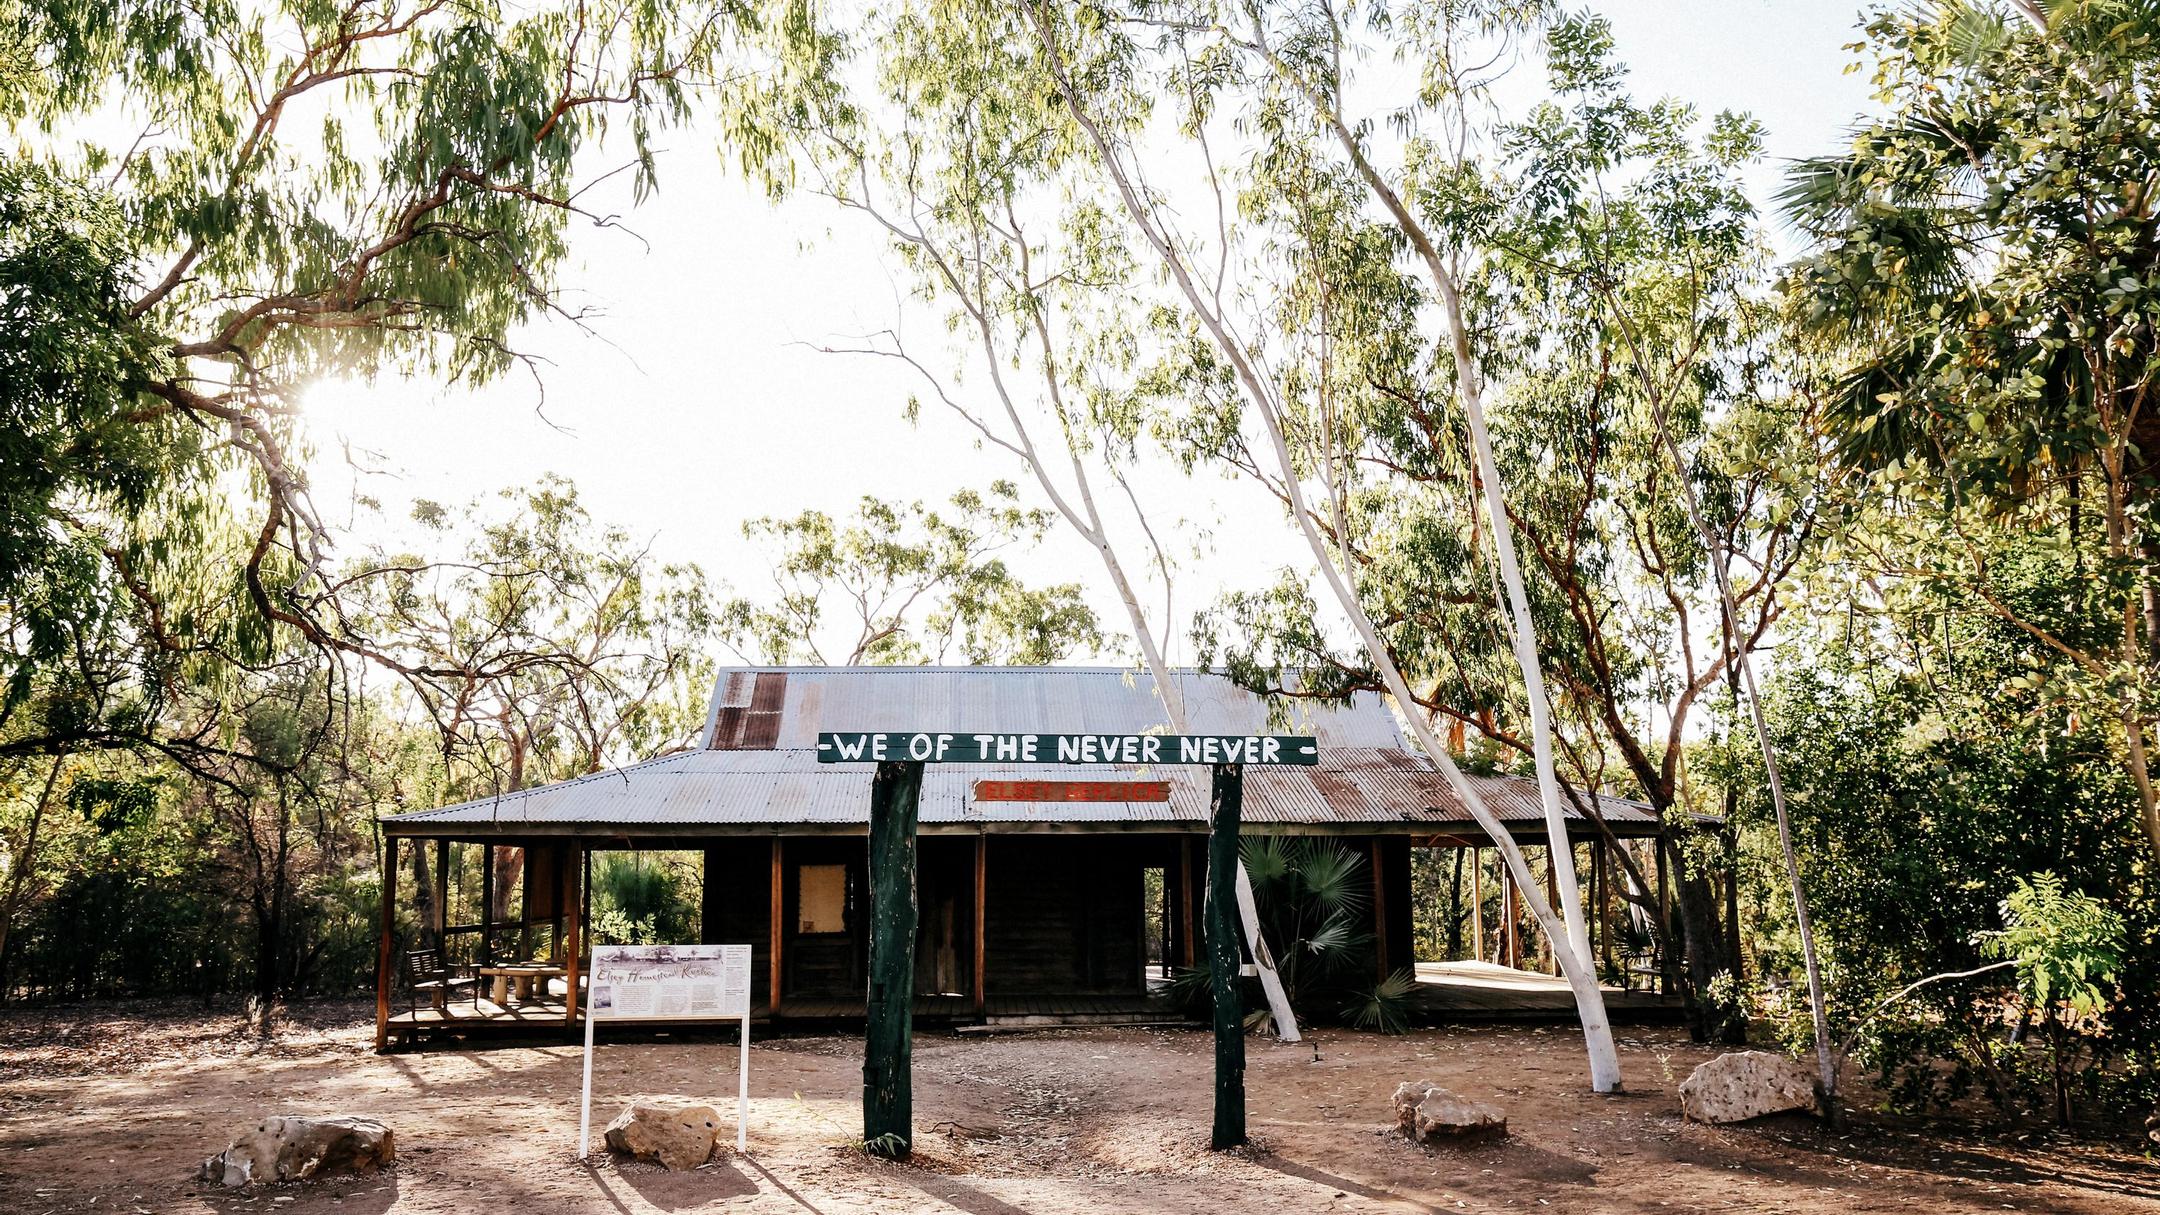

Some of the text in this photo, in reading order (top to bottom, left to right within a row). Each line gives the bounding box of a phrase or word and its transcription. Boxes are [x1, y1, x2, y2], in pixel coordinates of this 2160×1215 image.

[909, 733, 954, 761] OF
[973, 734, 1039, 761] THE
[1057, 735, 1161, 763] NEVER
[1180, 736, 1281, 764] NEVER
